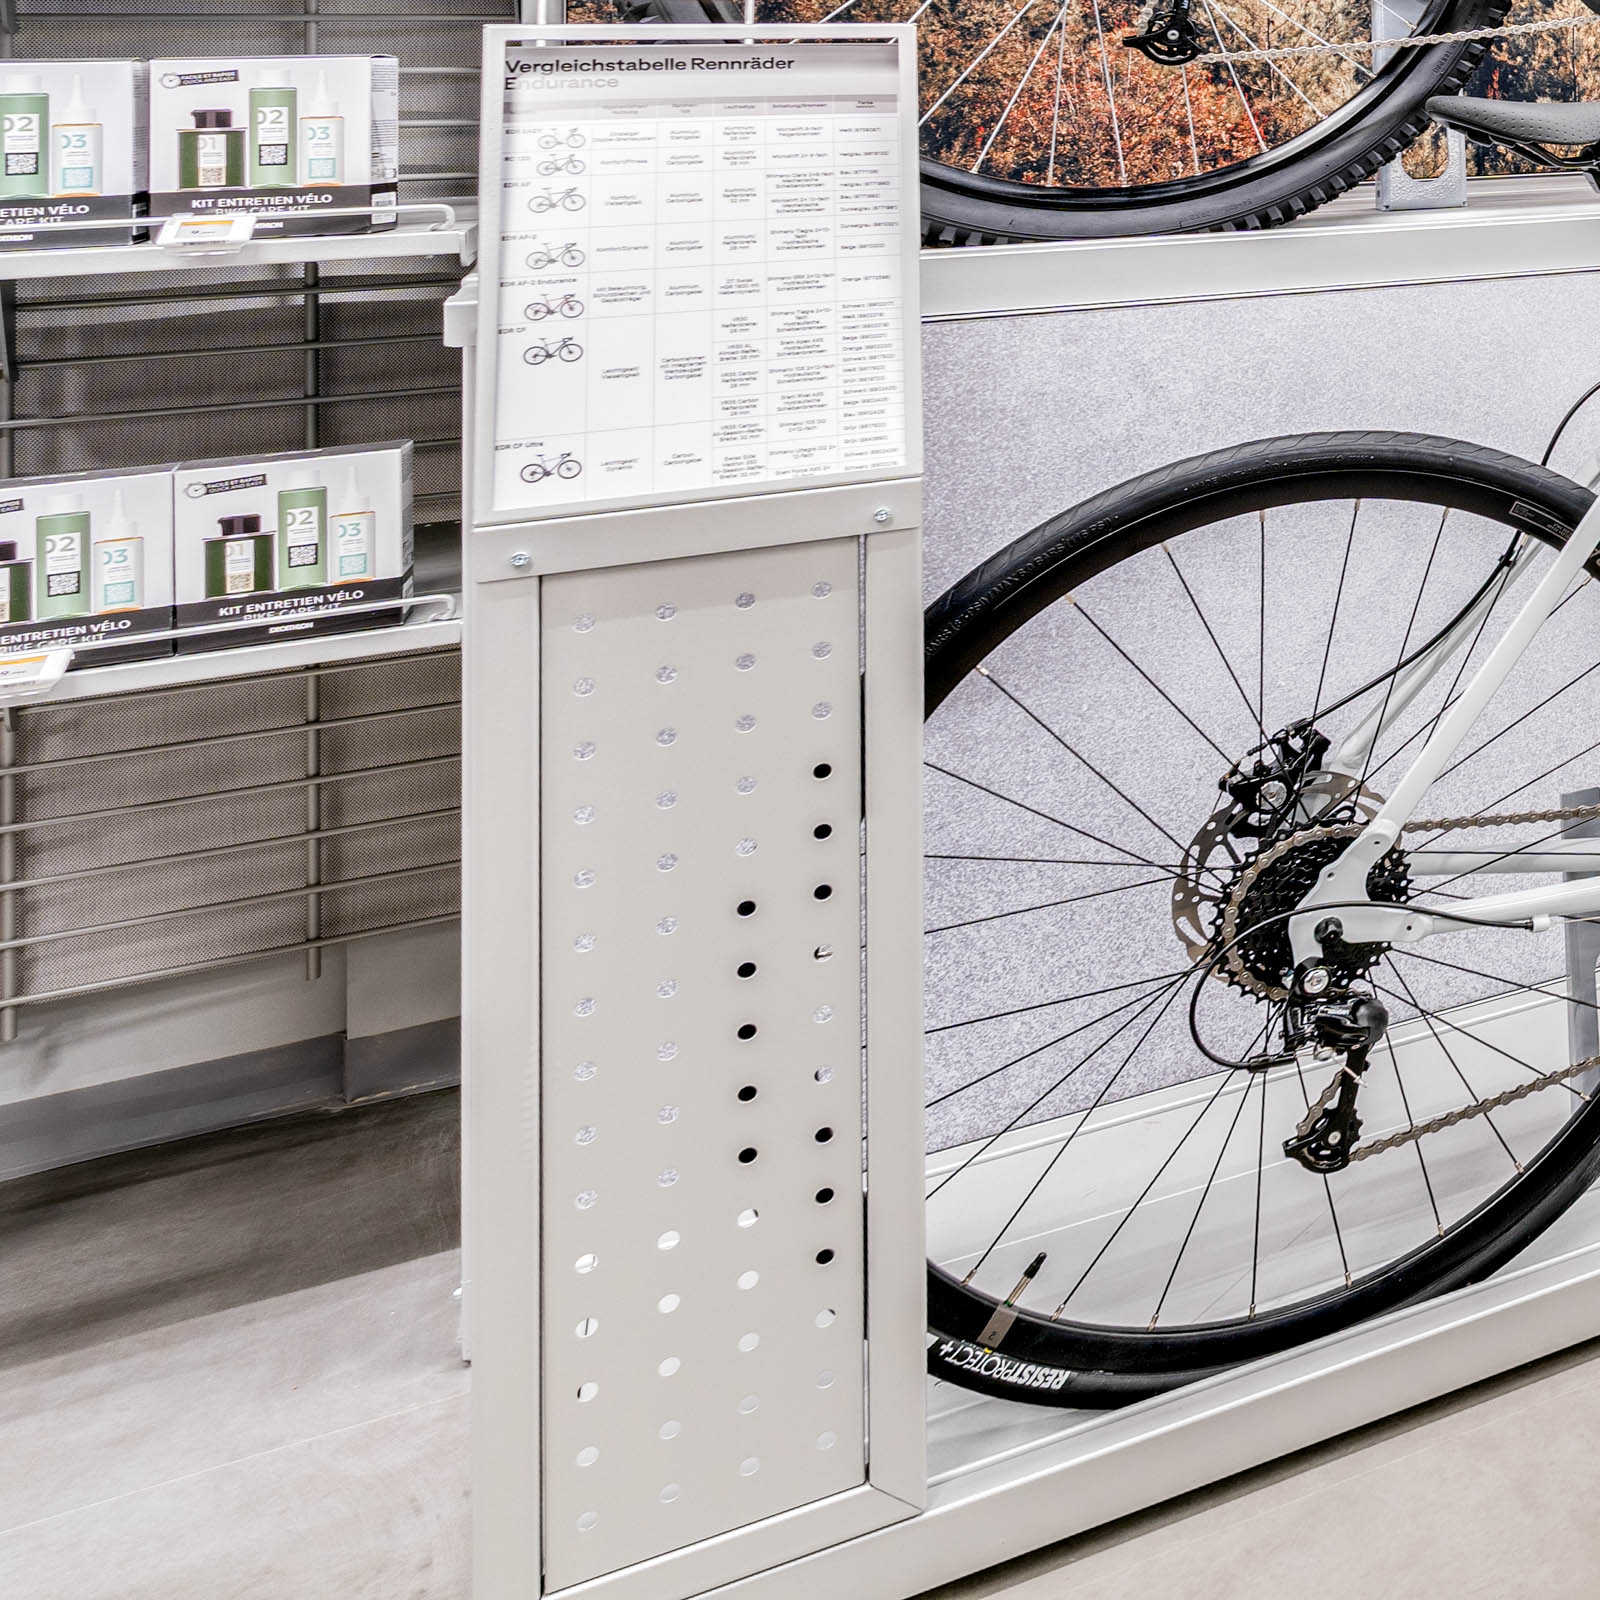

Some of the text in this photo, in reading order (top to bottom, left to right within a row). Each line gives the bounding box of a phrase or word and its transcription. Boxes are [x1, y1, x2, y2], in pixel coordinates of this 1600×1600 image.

[505, 57, 795, 75] Vergleichstabelle Rennräder
[505, 75, 620, 90] Endurance
[48, 203, 90, 217] VÉLO
[192, 192, 332, 210] KIT ENTRETIEN VÉLO
[218, 589, 364, 617] KIT ENTRETIEN VÉLO
[89, 618, 132, 635] VÉLO
[940, 1340, 1071, 1390] RESISTPROTECT+
